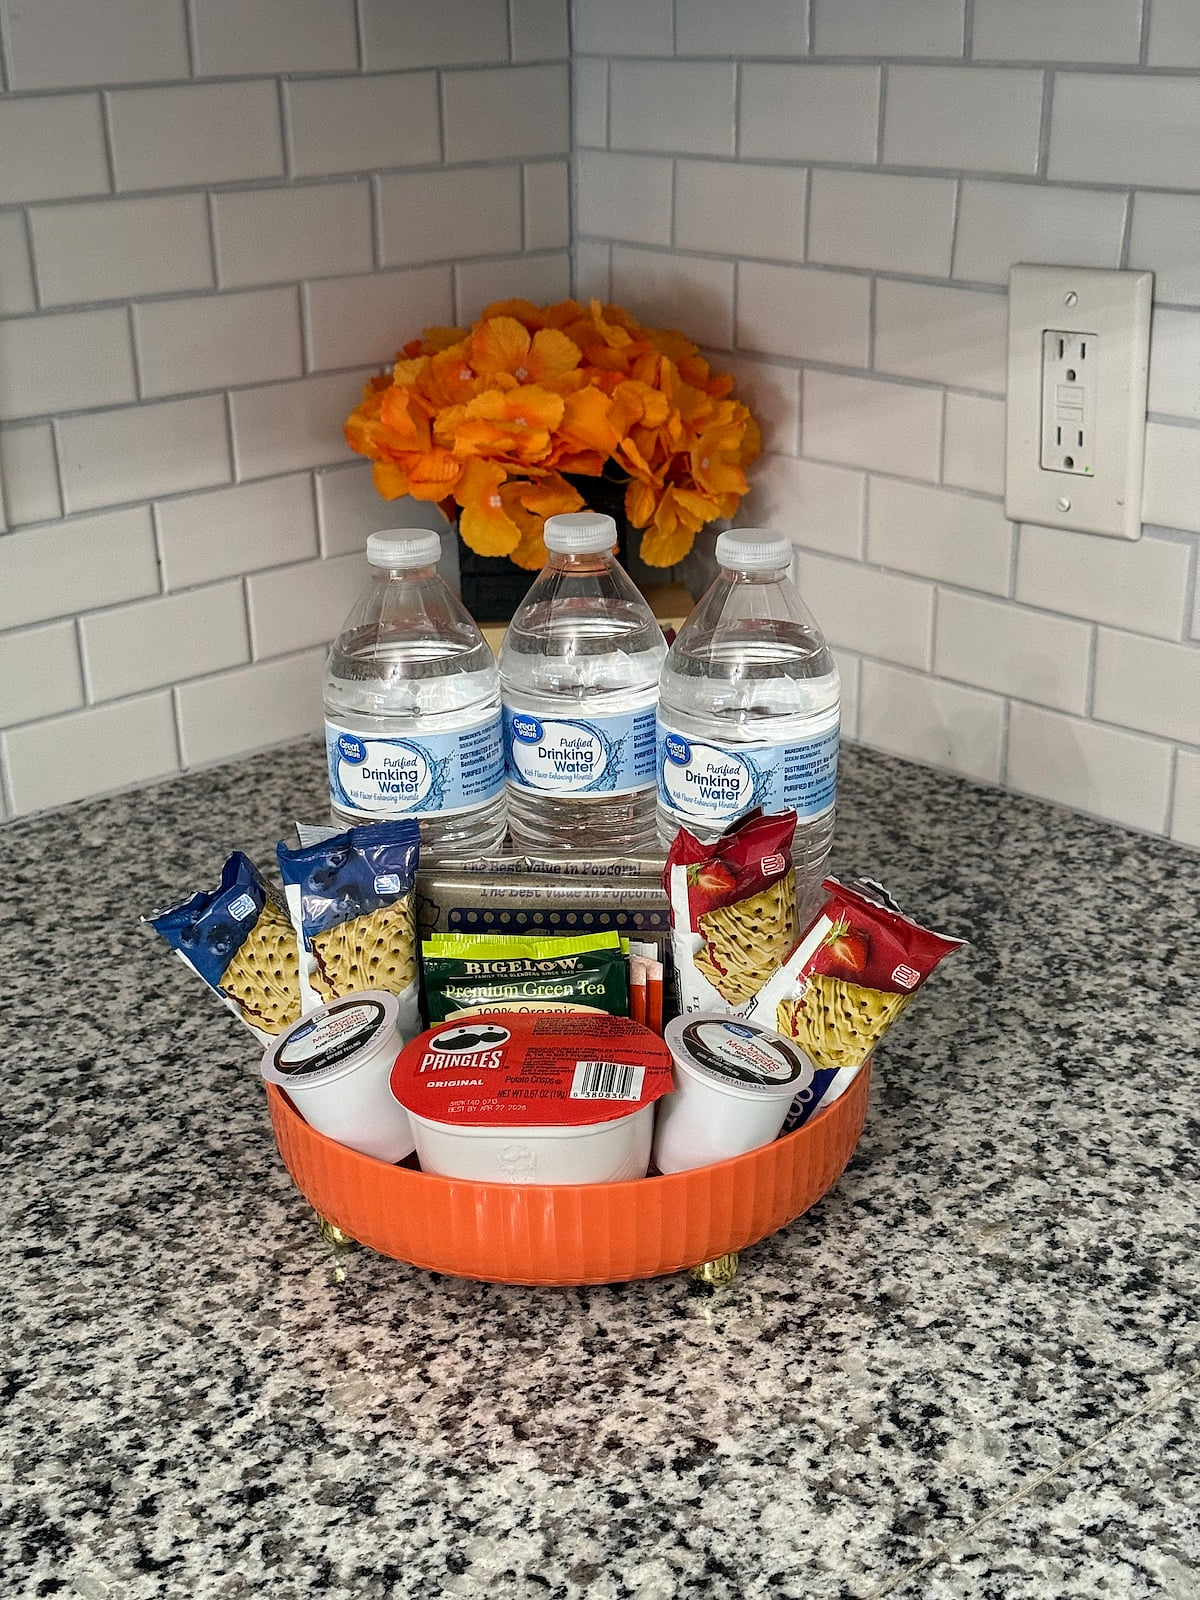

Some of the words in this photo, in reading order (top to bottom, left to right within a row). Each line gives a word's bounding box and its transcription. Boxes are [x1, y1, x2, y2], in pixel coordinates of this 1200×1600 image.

[513, 719, 537, 733] Great
[519, 728, 537, 738] Value
[340, 738, 360, 753] Great
[560, 737, 594, 750] Purified
[666, 738, 686, 754] Great
[345, 749, 361, 759] Value
[538, 747, 594, 762] Drinking
[671, 749, 686, 760] Value
[383, 756, 418, 770] Purified
[554, 761, 594, 773] Water
[706, 763, 742, 776] Purified
[362, 767, 418, 783] Drinking
[686, 770, 740, 790] Drinking
[378, 781, 419, 793] Water
[699, 786, 741, 800] Water
[463, 860, 487, 872] The
[491, 860, 522, 873] Best
[524, 860, 561, 874] Value
[563, 861, 579, 875] In
[581, 861, 641, 876] Popcorn!
[464, 957, 579, 975] BIGELOW
[445, 982, 519, 998] Premium
[522, 981, 574, 997] Green
[577, 980, 606, 996] Tea
[419, 1050, 503, 1073] PRINGLES
[725, 1039, 775, 1073] Macchiato
[427, 1079, 484, 1088] ORIGINAL
[505, 1075, 530, 1084] Potato
[531, 1075, 555, 1085] Crisps
[497, 1089, 510, 1098] NET
[512, 1089, 522, 1098] WT
[525, 1089, 538, 1098] 0.67
[540, 1089, 549, 1098] OZ
[550, 1089, 568, 1099] (19g)
[447, 1105, 465, 1113] BEST
